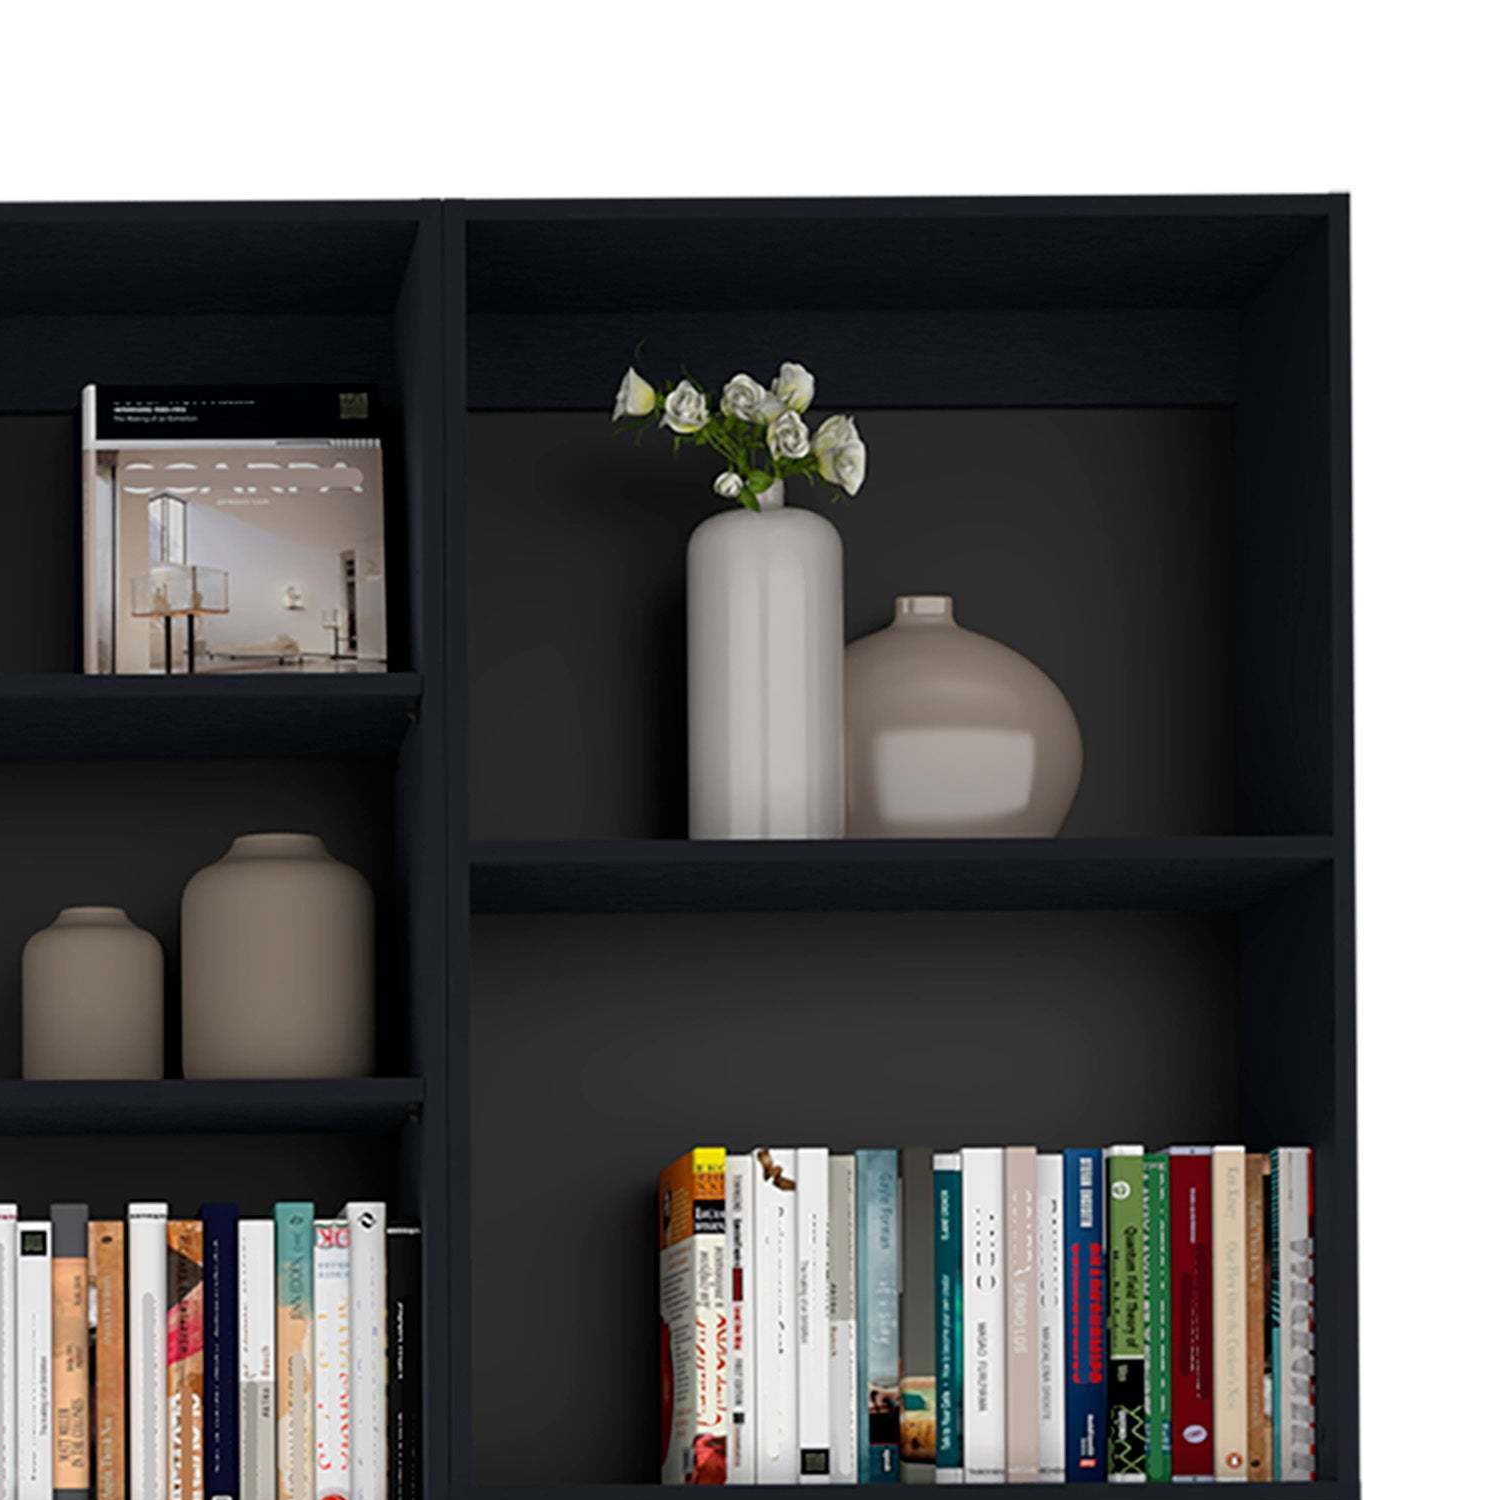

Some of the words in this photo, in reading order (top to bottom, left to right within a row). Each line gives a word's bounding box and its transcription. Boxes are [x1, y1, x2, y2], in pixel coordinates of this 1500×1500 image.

[1123, 1226, 1138, 1272] Quantum
[1126, 1275, 1138, 1299] Field
[1122, 1302, 1138, 1334] Theory
[1126, 1337, 1139, 1348] of
